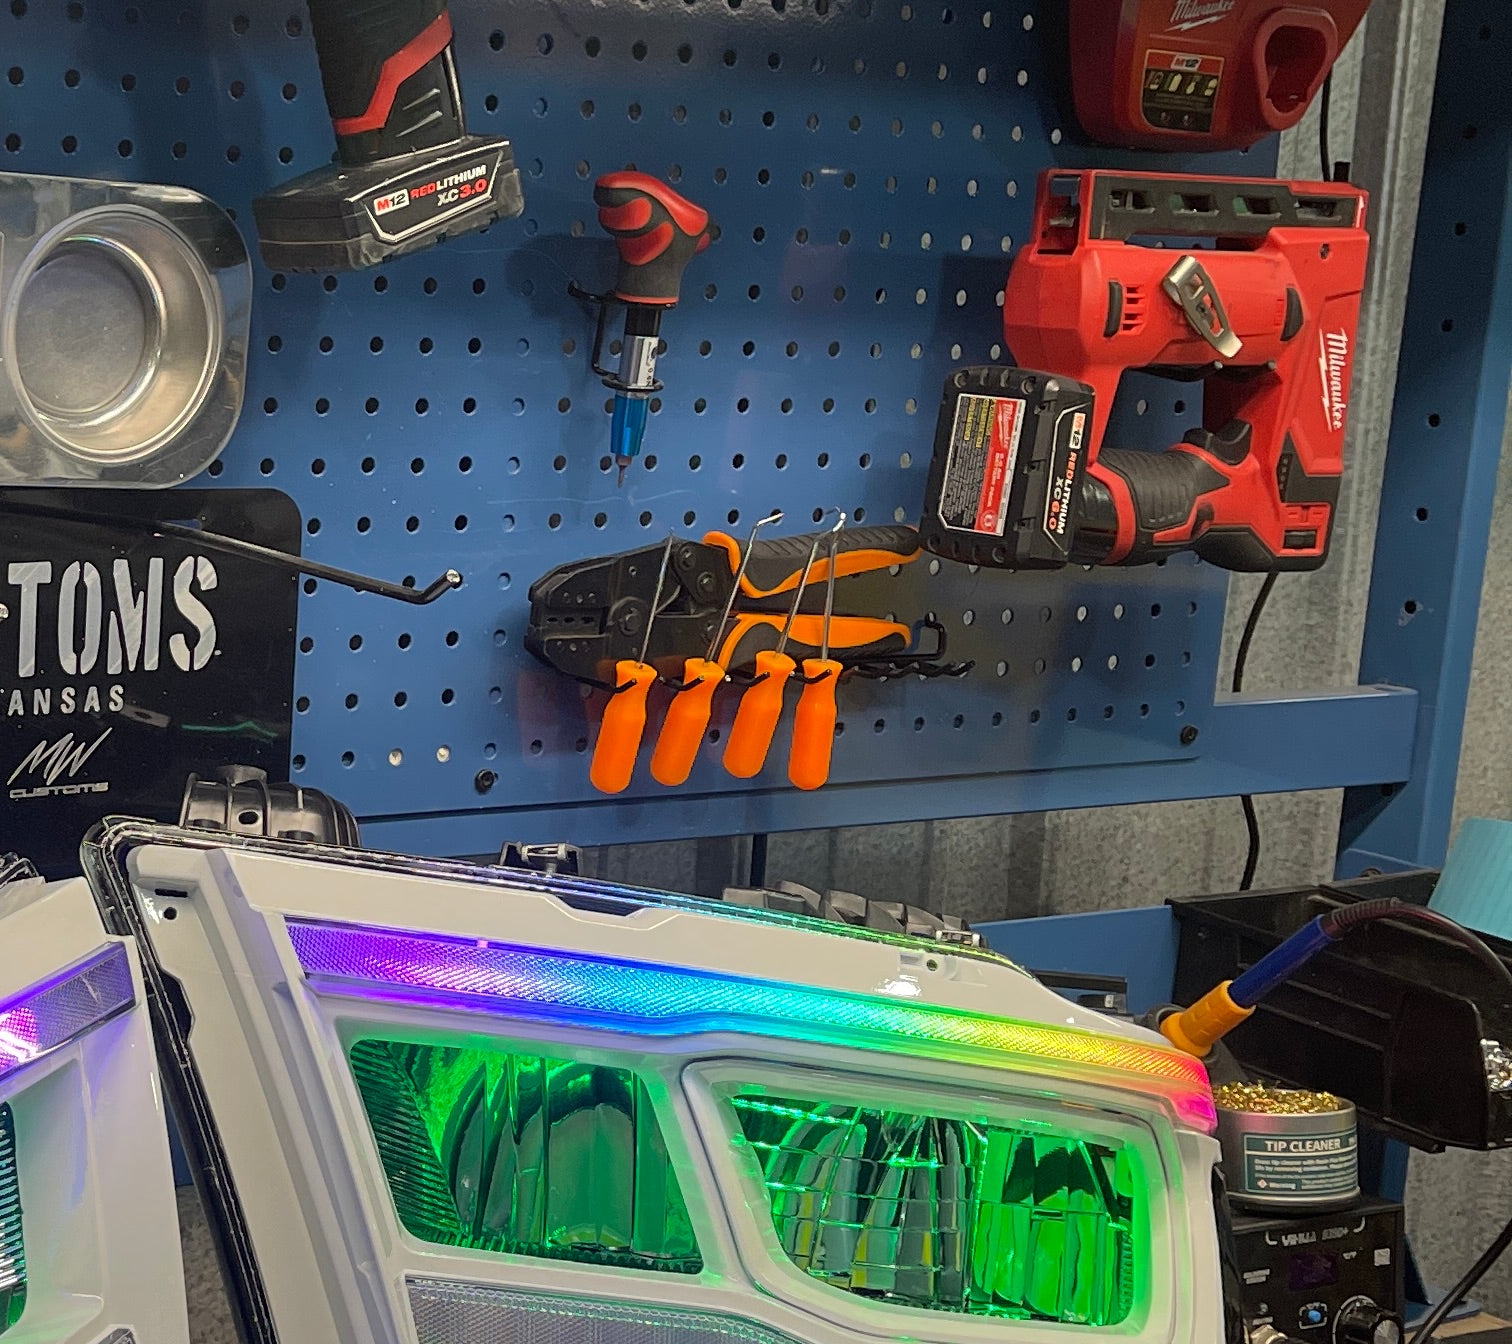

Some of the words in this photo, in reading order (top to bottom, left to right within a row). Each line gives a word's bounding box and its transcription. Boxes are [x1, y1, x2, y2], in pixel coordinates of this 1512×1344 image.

[377, 193, 406, 212] M12
[1326, 328, 1349, 430] Milwaukee
[1265, 1140, 1287, 1152] TIP
[1289, 1138, 1341, 1152] CLEANER
